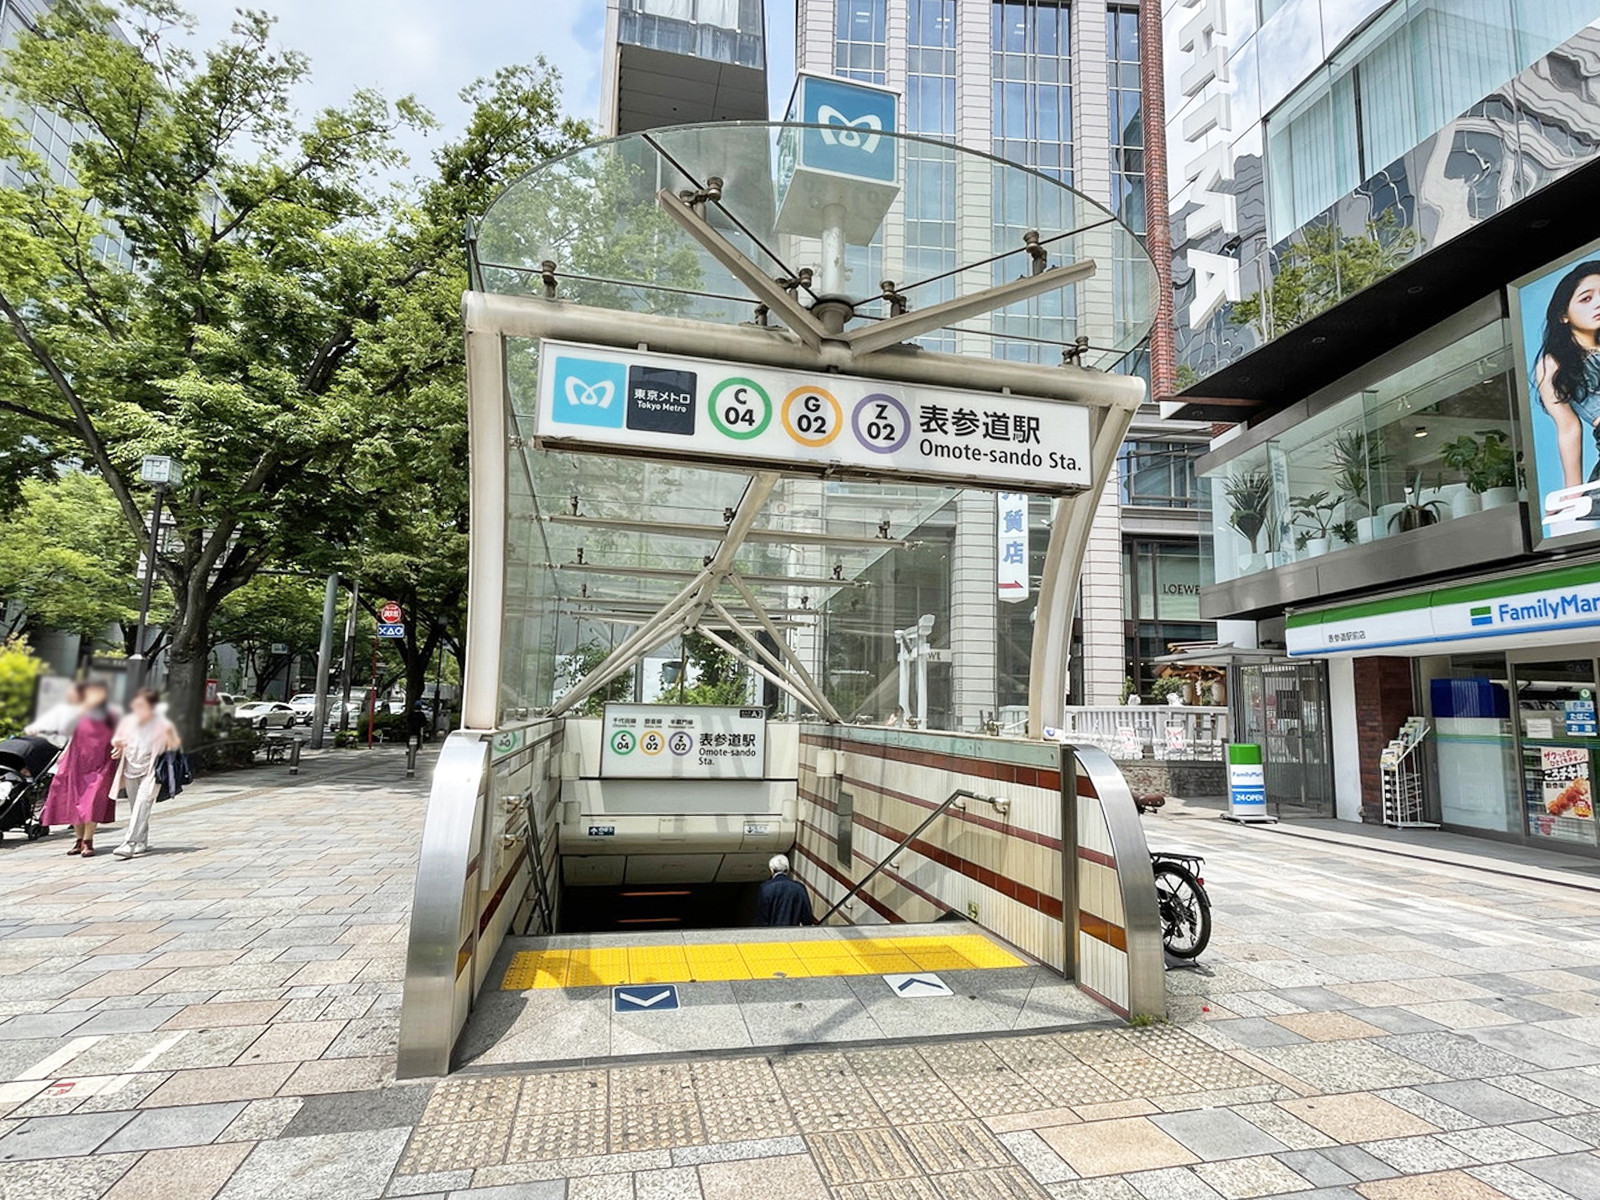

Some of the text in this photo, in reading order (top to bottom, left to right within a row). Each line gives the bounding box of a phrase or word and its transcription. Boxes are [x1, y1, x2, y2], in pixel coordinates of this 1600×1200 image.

[1178, 0, 1241, 330] HIMA
[633, 388, 690, 405] 東京メトロ
[734, 388, 748, 405] C
[804, 395, 821, 413] G
[637, 400, 687, 413] Tokyo Metro
[875, 404, 888, 420] Z
[724, 406, 756, 427] 04
[797, 414, 827, 434] 02
[867, 422, 896, 441] 02
[919, 405, 1041, 445] 表参道駅
[919, 438, 1082, 471] Omote-sando Sta.
[1002, 493, 1024, 565] 質店
[1162, 583, 1200, 595] LOEWE
[616, 742, 629, 750] 04
[646, 742, 659, 750] 02
[648, 734, 656, 742] G
[699, 733, 756, 747] 表参道駅
[674, 743, 687, 751] 02
[699, 747, 756, 757] Omote-sando
[698, 757, 715, 766] Sta.
